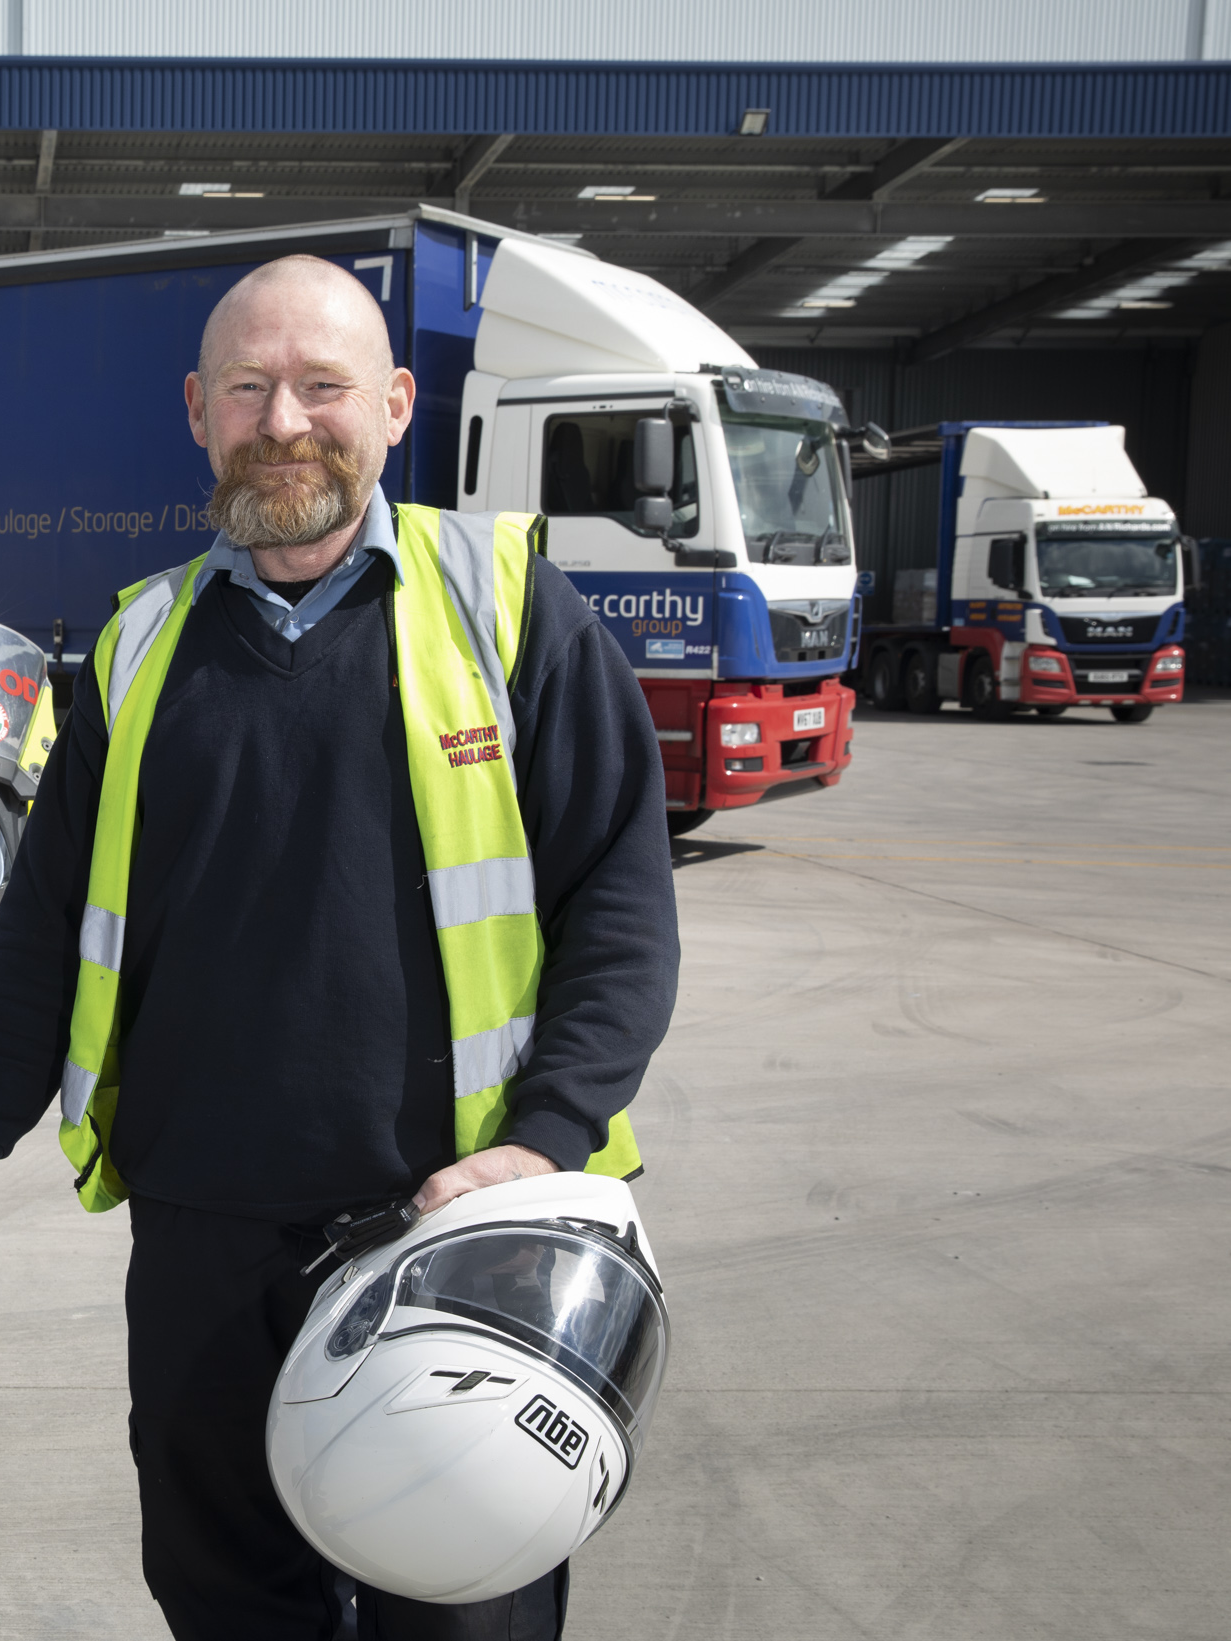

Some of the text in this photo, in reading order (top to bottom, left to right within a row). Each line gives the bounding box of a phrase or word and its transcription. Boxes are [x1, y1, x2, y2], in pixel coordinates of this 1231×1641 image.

[70, 506, 154, 538] Storage
[631, 619, 683, 637] group
[1086, 626, 1133, 638] MAN
[801, 630, 829, 648] MAN
[439, 724, 499, 750] McCARTHY
[448, 743, 502, 768] HAULAGE
